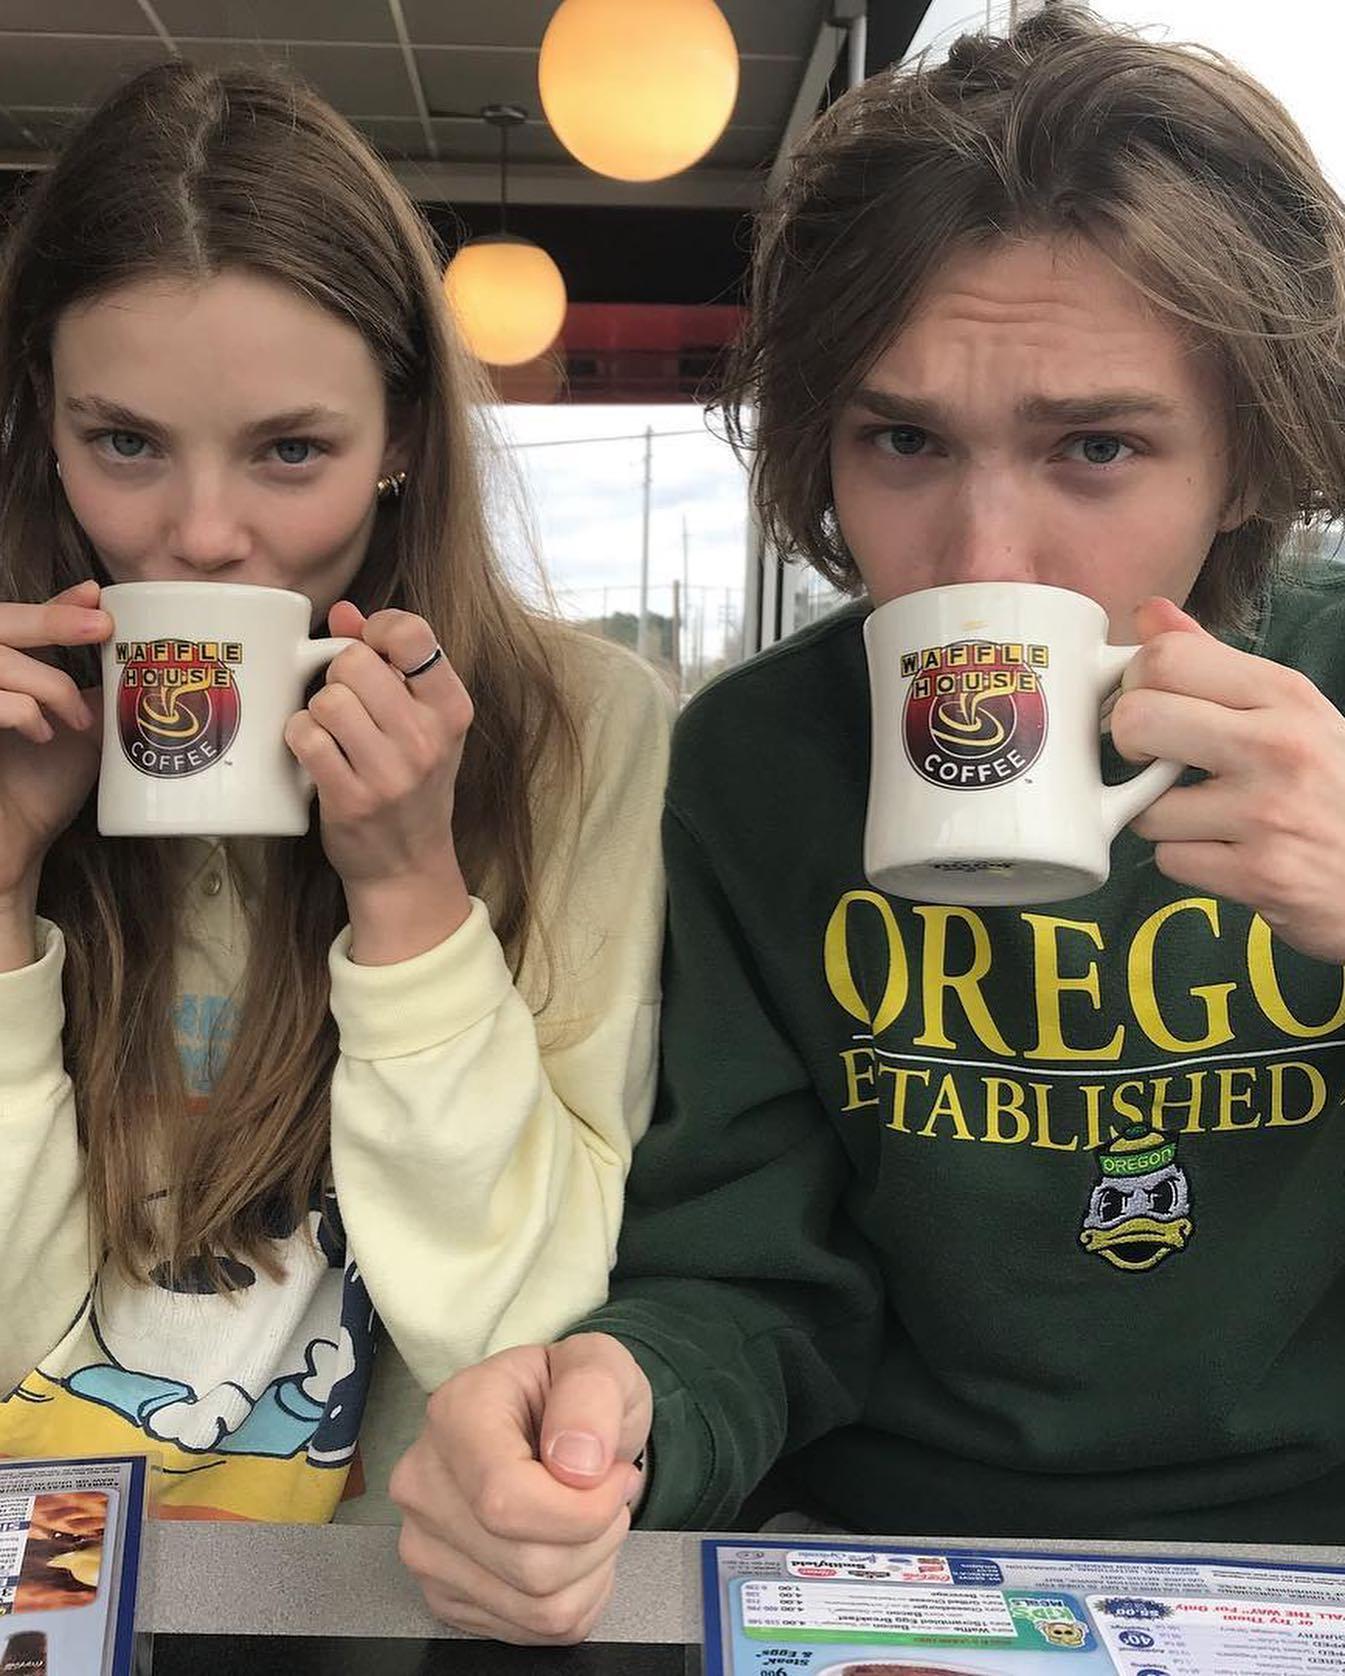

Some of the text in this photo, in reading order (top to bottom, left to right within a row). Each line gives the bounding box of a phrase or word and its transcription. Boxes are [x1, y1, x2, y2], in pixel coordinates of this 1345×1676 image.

[116, 643, 241, 662] WAFFLE
[902, 644, 1048, 676] WAFFLE
[125, 669, 229, 686] HOUSE
[914, 671, 1036, 698] HOUSE
[131, 741, 216, 770] COFFEE
[924, 750, 1026, 783] COFFEE
[1103, 1148, 1171, 1172] OREGON
[791, 1560, 865, 1569] Smithfield
[1175, 1604, 1208, 1612] Only
[1214, 1606, 1237, 1614] For
[1286, 1611, 1311, 1619] THE
[1223, 1615, 1263, 1624] Them
[1269, 1617, 1291, 1626] Try
